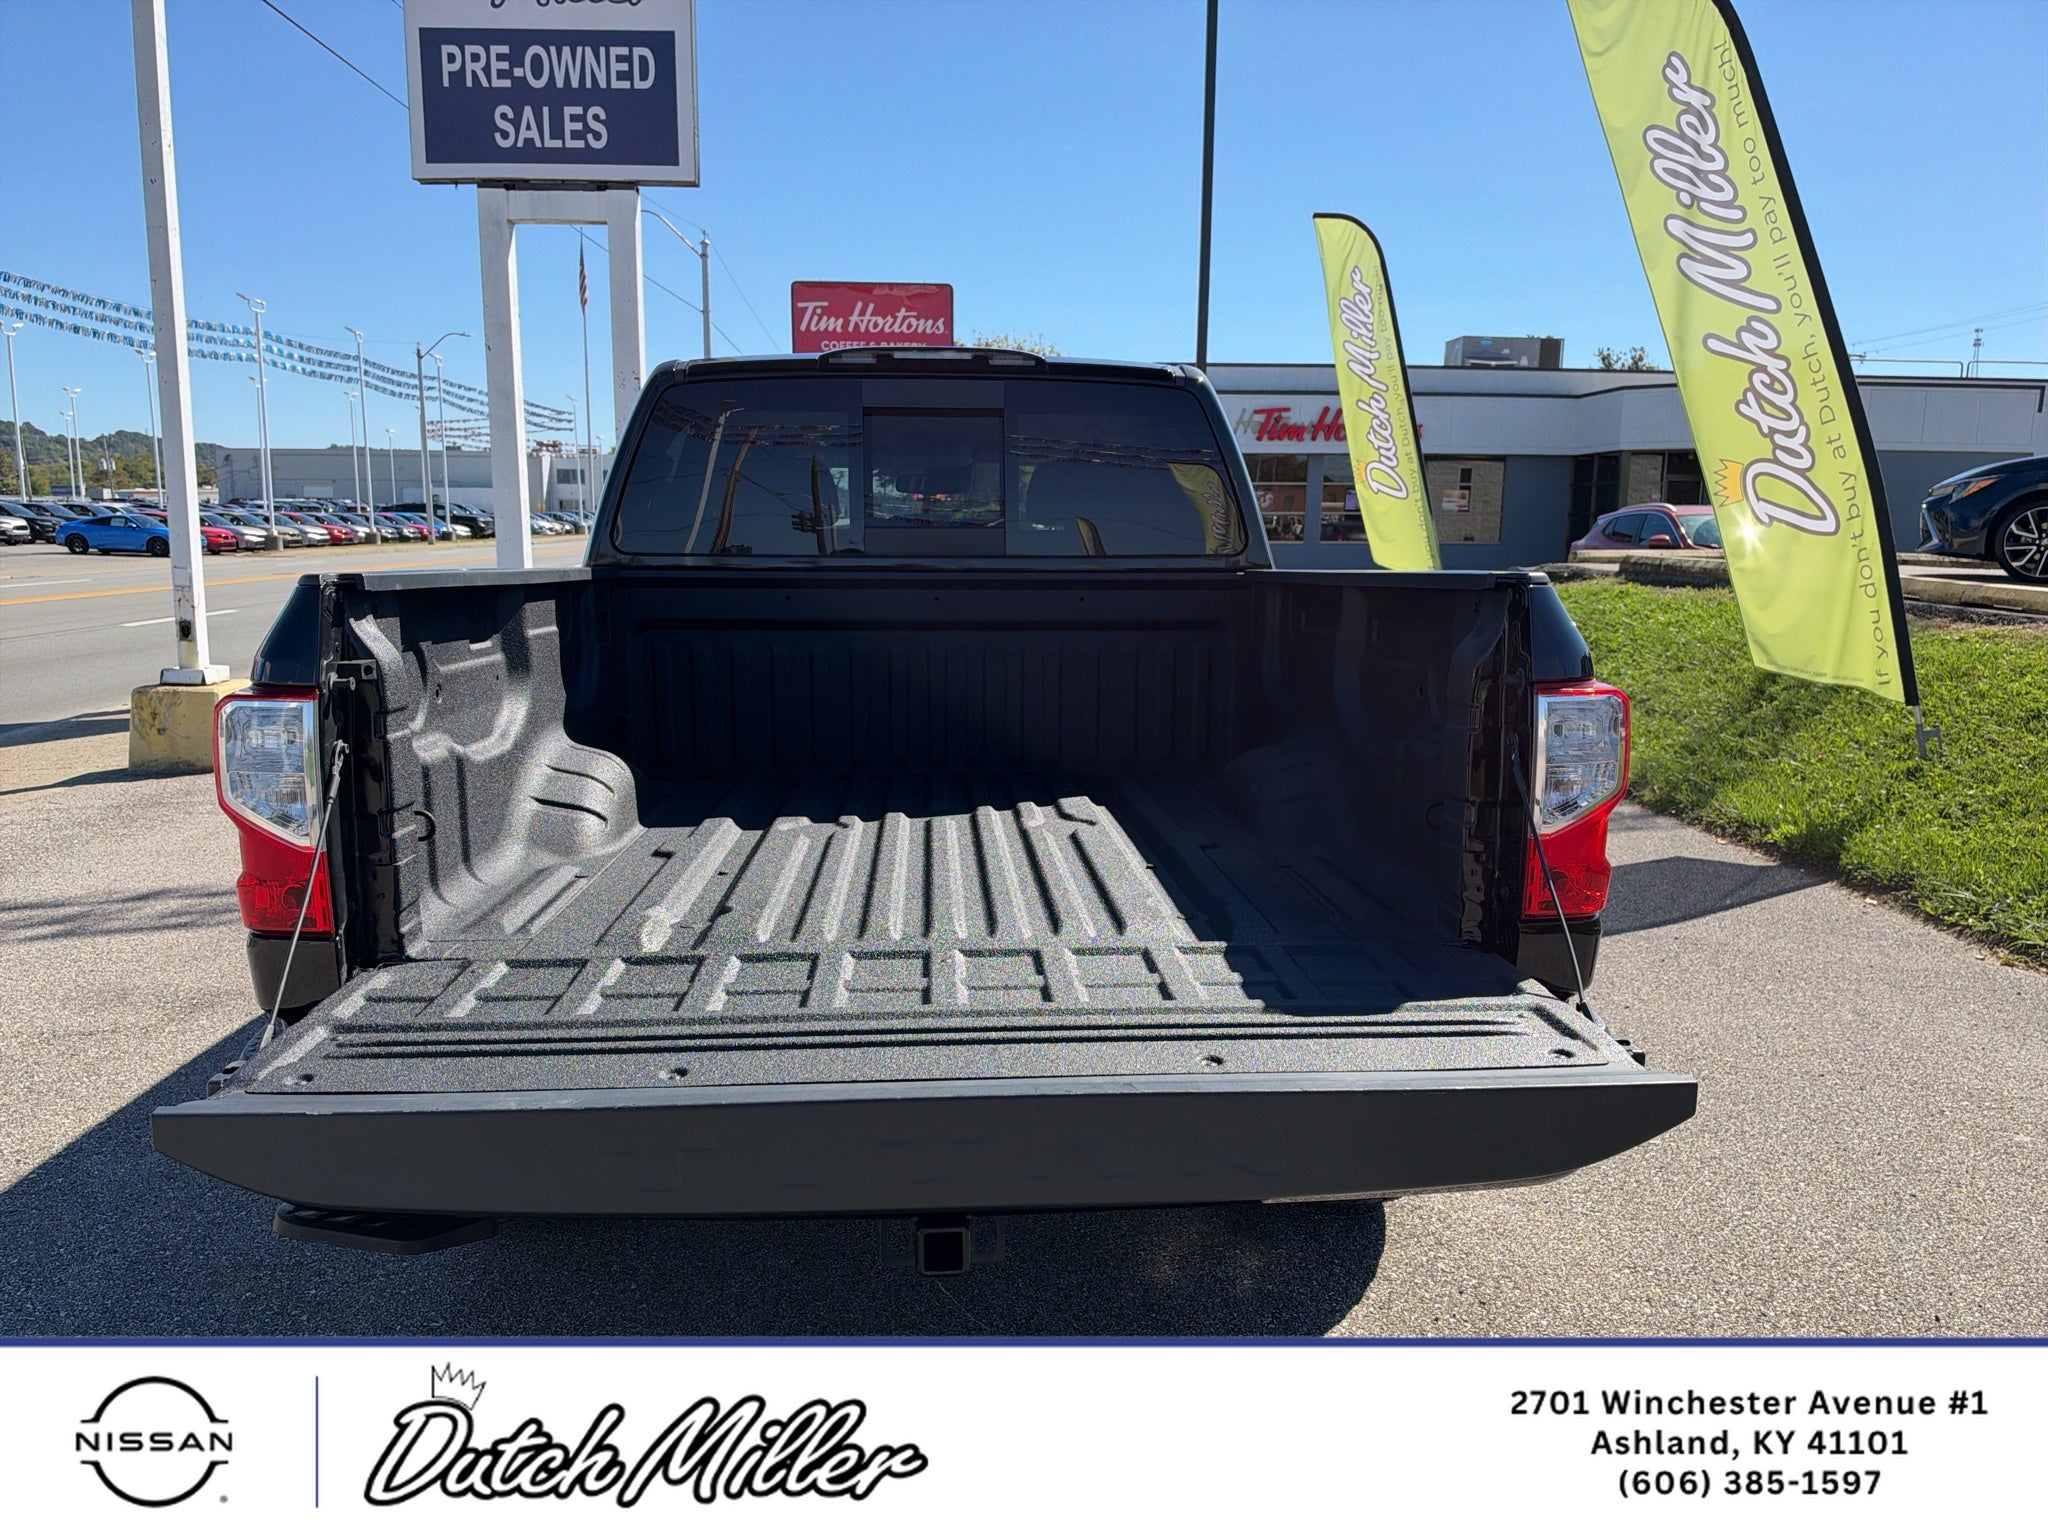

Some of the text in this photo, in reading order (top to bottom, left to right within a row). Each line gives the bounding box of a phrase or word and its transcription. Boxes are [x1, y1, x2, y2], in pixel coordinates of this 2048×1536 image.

[440, 44, 656, 90] PRE-OWNED
[493, 104, 609, 150] SALES
[1643, 51, 1782, 314] Miller
[1742, 137, 1766, 186] too
[1758, 194, 1788, 245] pay
[1773, 252, 1813, 328] you'll
[797, 300, 946, 335] Tim Hortons
[1379, 311, 1388, 333] too
[1383, 337, 1394, 361] pay
[1339, 265, 1409, 500] Dutch Miller
[1254, 407, 1306, 442] Tim
[1702, 315, 1840, 536] Dutch
[1825, 432, 1848, 460] at
[1409, 469, 1419, 494] buy
[1838, 470, 1861, 522] buy
[1850, 527, 1878, 600] don't
[1868, 608, 1889, 660] you
[1875, 668, 1892, 685] If
